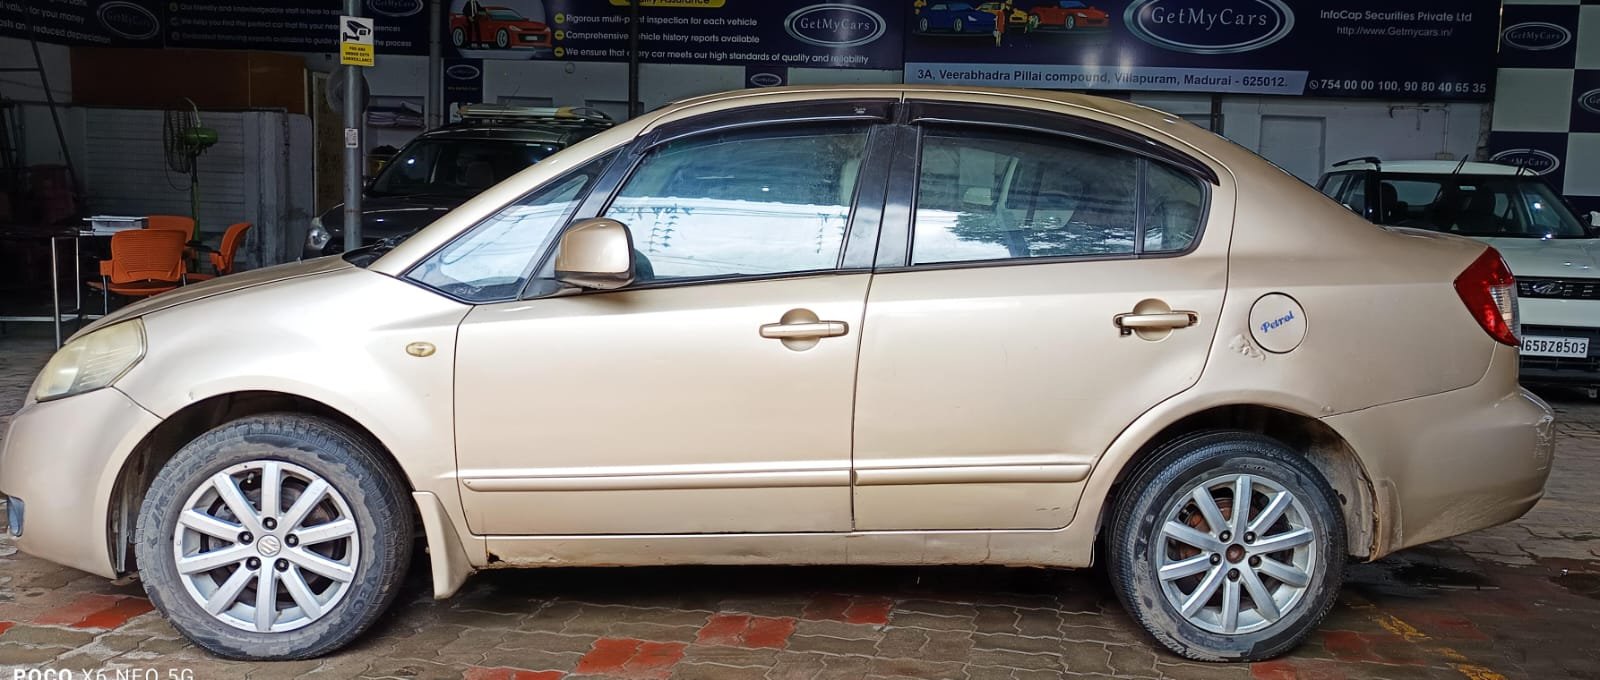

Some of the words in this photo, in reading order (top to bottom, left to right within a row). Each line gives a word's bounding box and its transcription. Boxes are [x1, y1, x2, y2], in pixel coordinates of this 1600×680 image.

[566, 14, 600, 24] Rigorous
[646, 15, 689, 26] inspection
[690, 16, 701, 24] for
[703, 16, 725, 25] each
[727, 17, 758, 26] vehicle
[1151, 6, 1268, 32] GetMyCars
[1320, 9, 1363, 21] InfoCap
[1364, 10, 1415, 21] Securities
[1417, 11, 1454, 22] Private
[1456, 12, 1472, 22] Ltd
[800, 17, 871, 33] GetMyCars
[566, 31, 630, 42] Comprehensive
[663, 33, 689, 44] history
[690, 34, 720, 44] reports
[721, 34, 760, 44] available
[1510, 31, 1562, 41] GetMyCars
[385, 40, 412, 48] process
[566, 48, 579, 56] We
[580, 49, 607, 57] ensure
[609, 48, 625, 57] that
[667, 51, 692, 59] meets
[694, 52, 708, 60] our
[709, 51, 727, 62] high
[729, 52, 769, 61] standards
[771, 53, 781, 61] of
[781, 53, 810, 63] quality
[812, 54, 829, 62] and
[830, 54, 869, 64] reliability
[917, 69, 935, 81] 3A,
[939, 70, 1010, 81] Veerabhadra
[1014, 71, 1041, 81] Pillai
[1045, 72, 1110, 84] compound,
[1115, 72, 1180, 86] Villapuram,
[1184, 75, 1232, 86] Madurai
[1242, 76, 1288, 87] 625012.
[1321, 79, 1341, 89] 754
[1344, 80, 1358, 90] 00
[1360, 80, 1374, 90] 00
[1378, 81, 1400, 92] 100,
[1404, 81, 1418, 91] 90
[1421, 81, 1435, 92] 80
[1438, 82, 1451, 92] 40
[1455, 82, 1469, 93] 65
[1472, 83, 1487, 93] 35
[1260, 310, 1294, 333] Petrol
